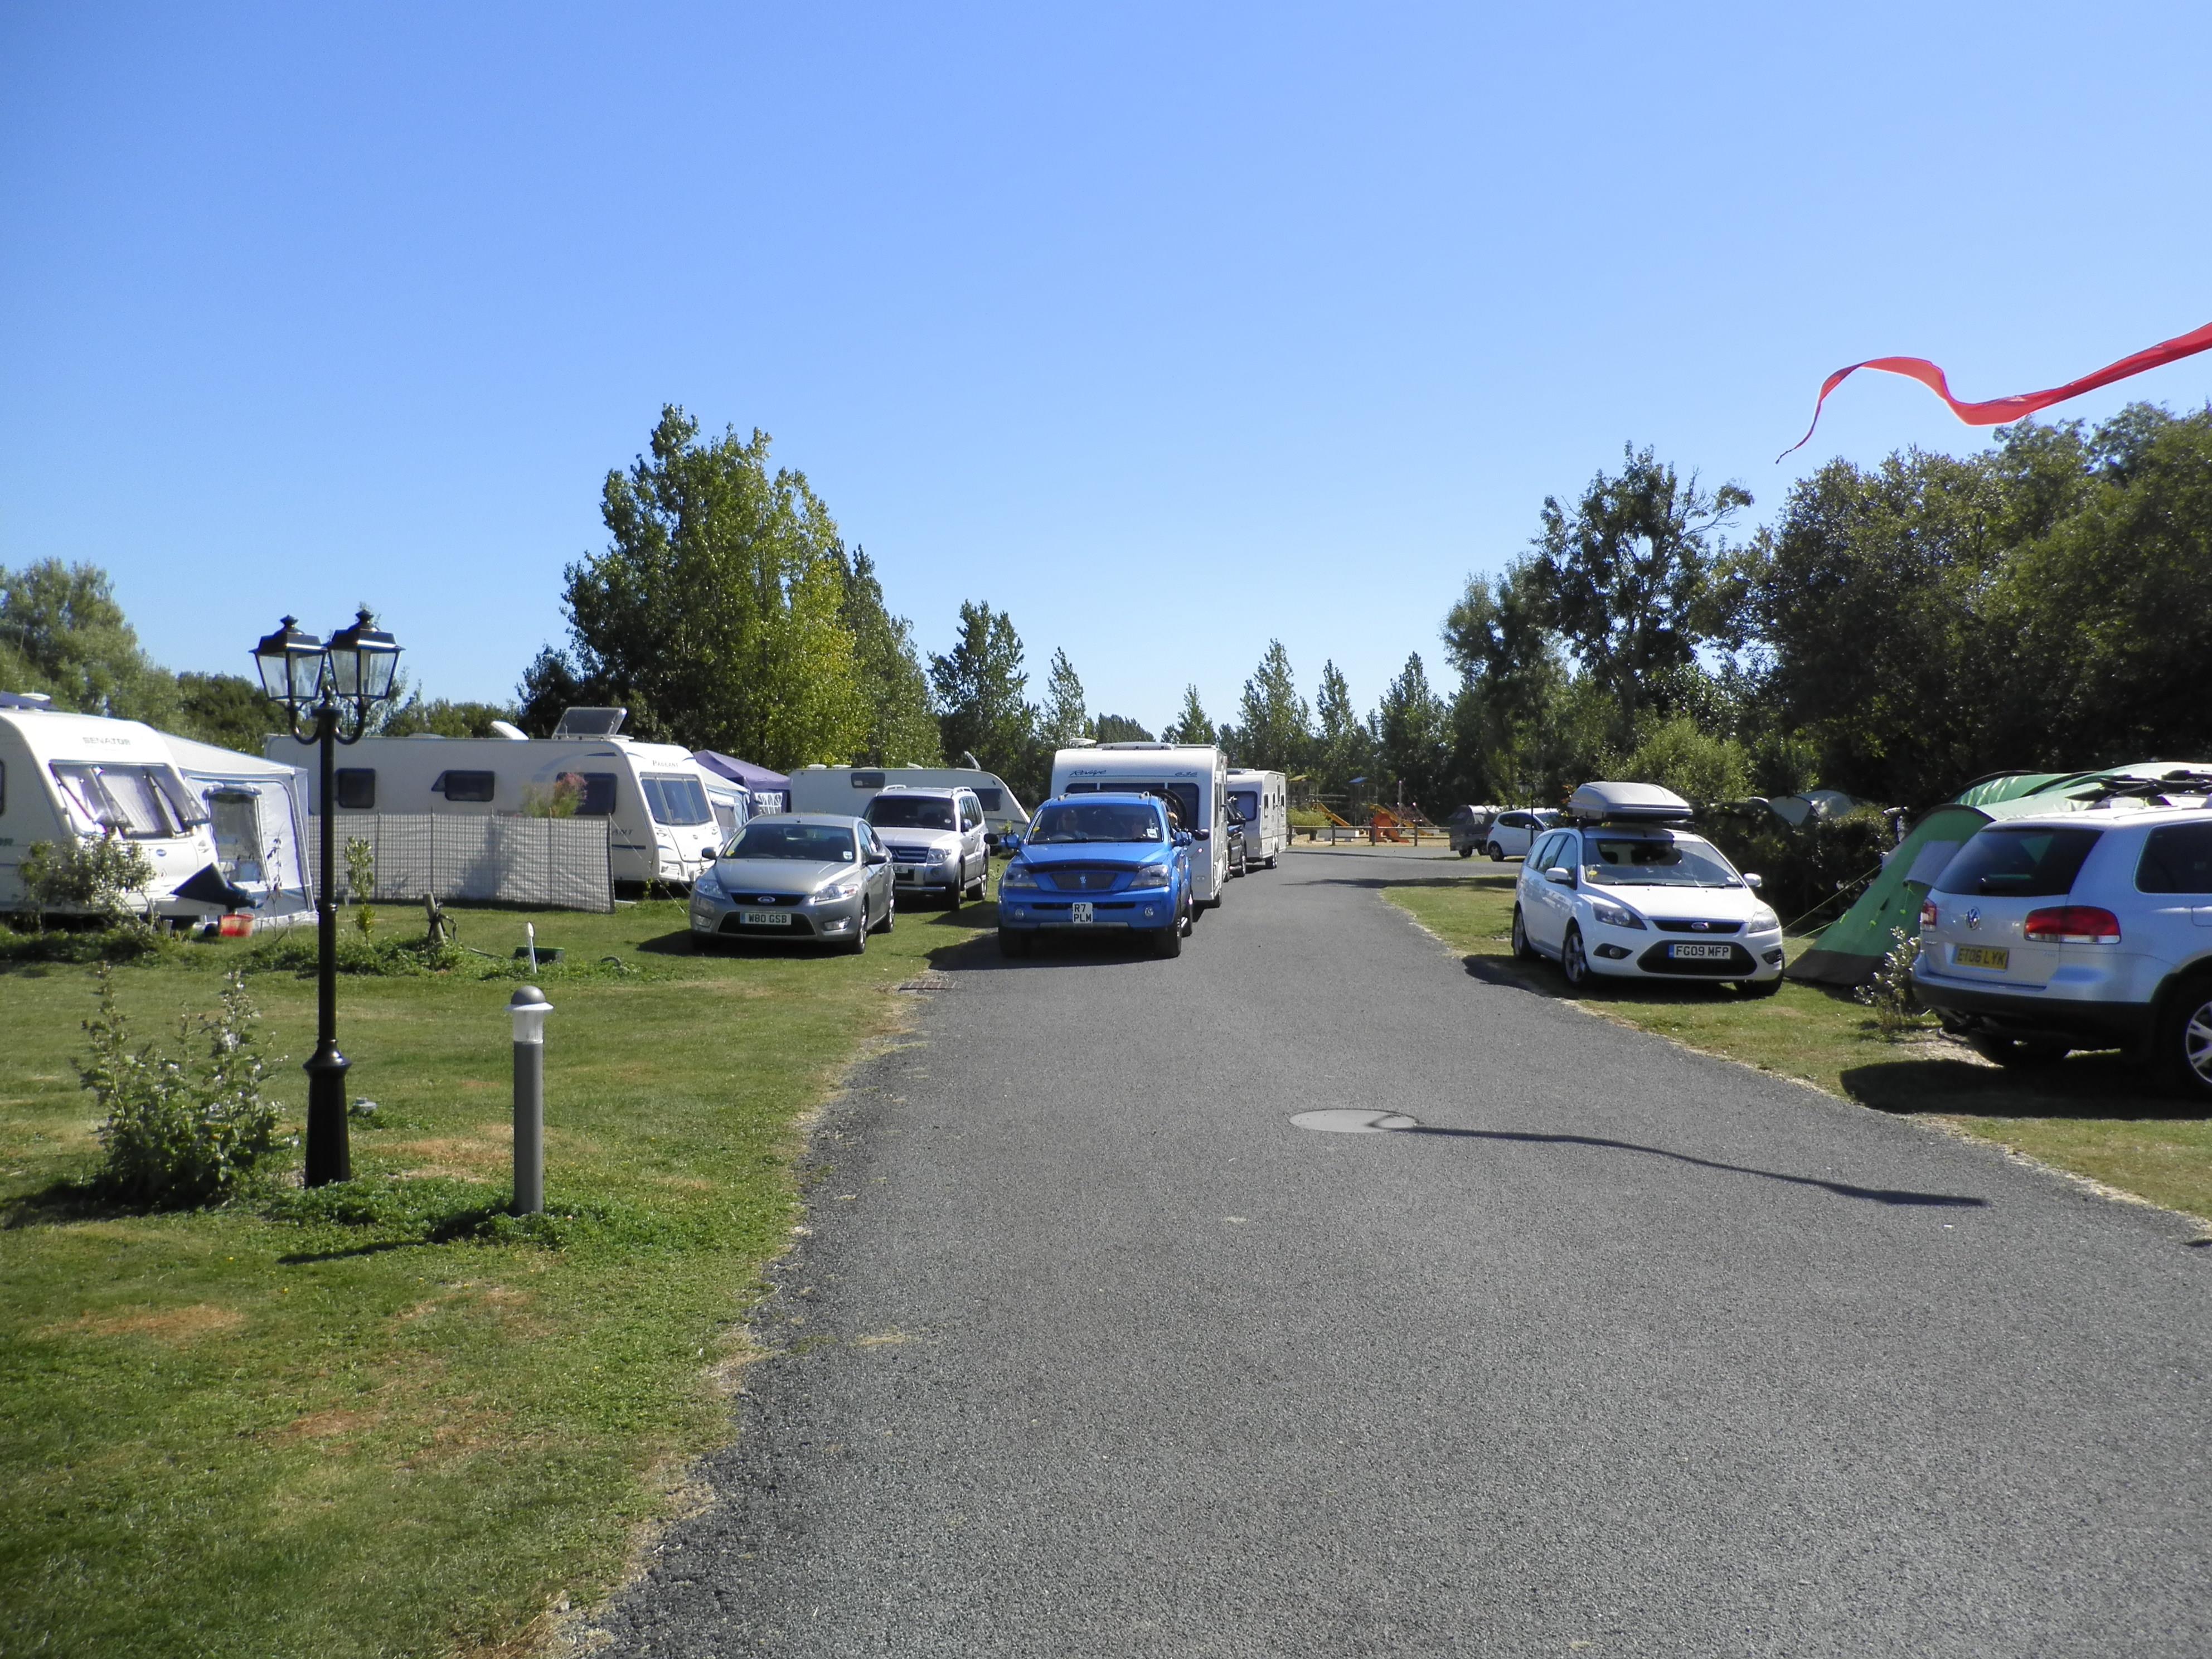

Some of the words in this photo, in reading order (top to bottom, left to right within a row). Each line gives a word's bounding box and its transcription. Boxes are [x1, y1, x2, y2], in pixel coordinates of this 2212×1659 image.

[83, 736, 131, 745] SENATOR
[1074, 904, 1086, 912] R7
[749, 914, 767, 923] W80
[769, 915, 787, 923] GSB
[1074, 914, 1092, 922] PLM
[1676, 946, 1705, 955] FG09
[1707, 947, 1729, 957] MFP
[1957, 949, 1982, 963] ET06
[1983, 951, 2006, 966] LYK
